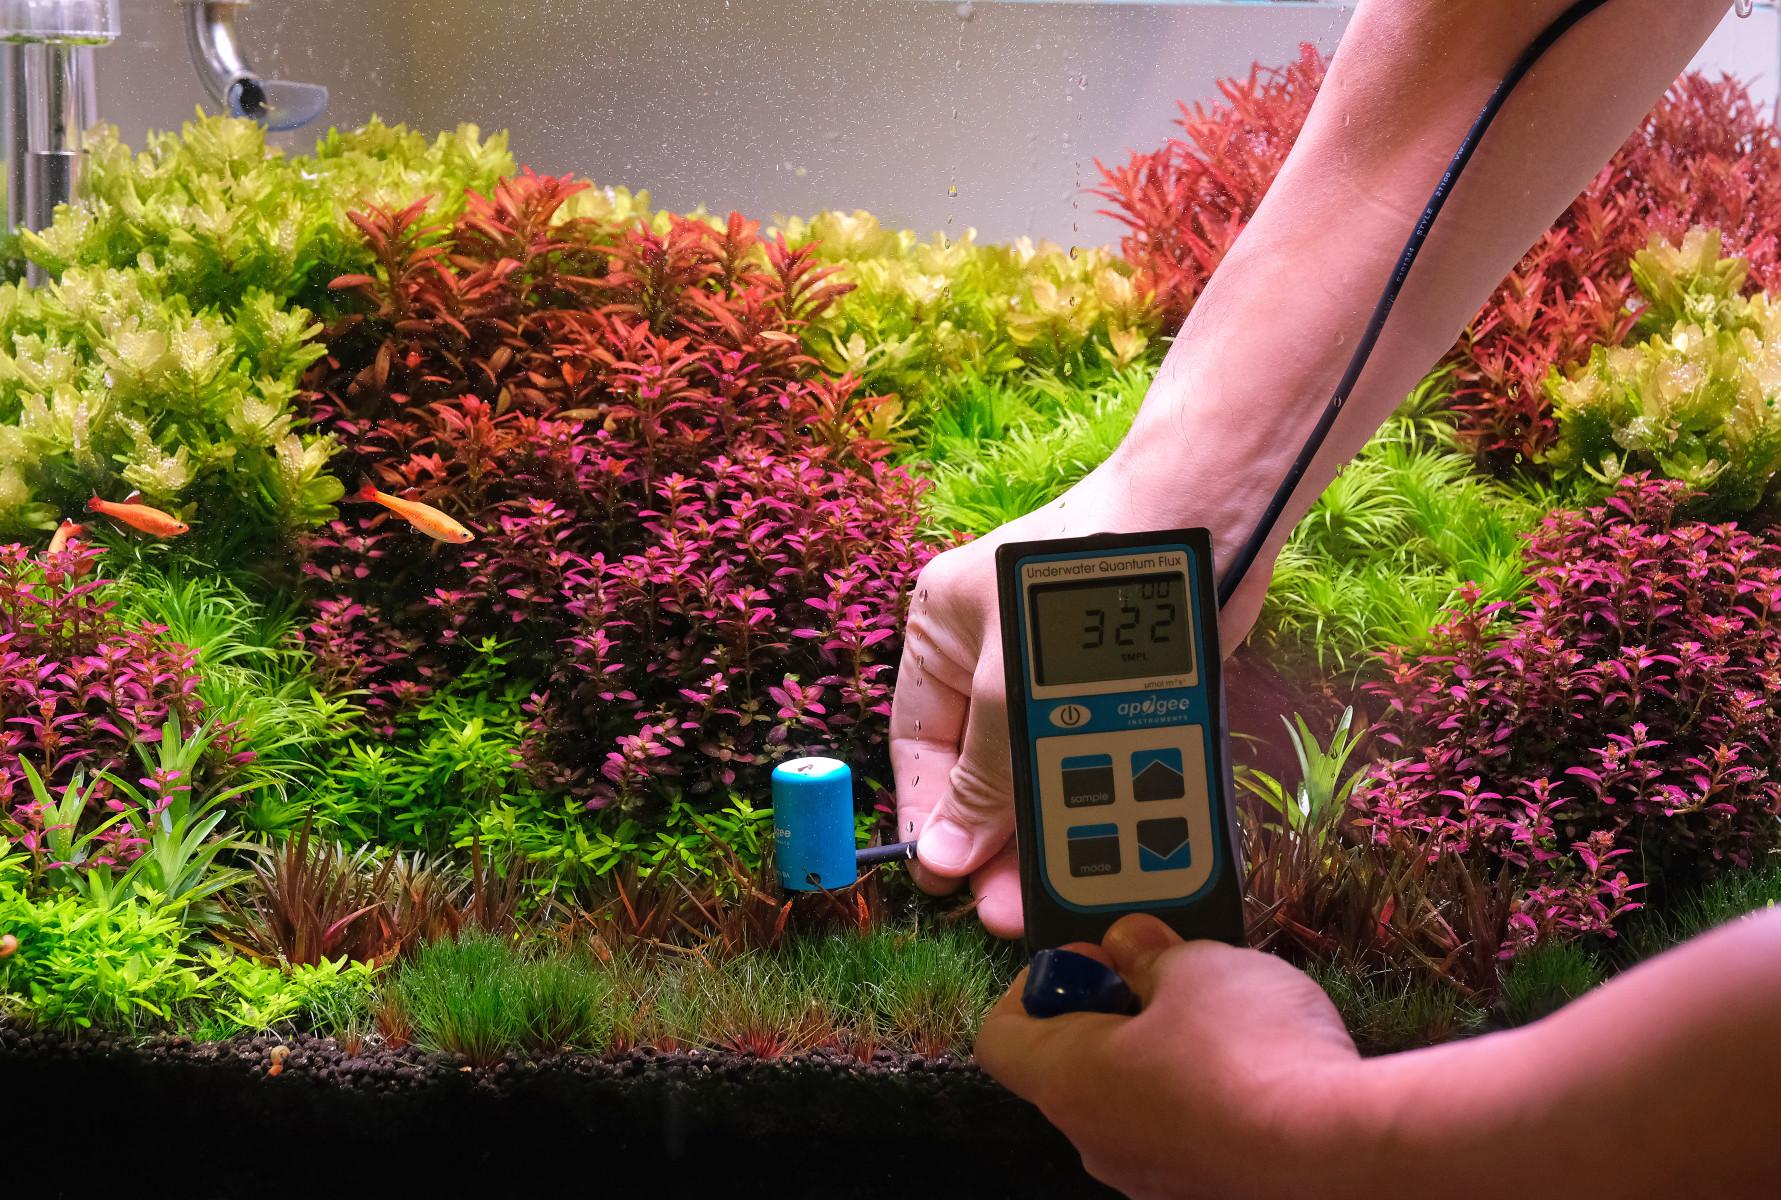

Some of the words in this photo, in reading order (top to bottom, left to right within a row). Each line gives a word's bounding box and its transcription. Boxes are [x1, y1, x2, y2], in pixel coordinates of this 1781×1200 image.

[1416, 207, 1434, 235] STYLE
[1435, 171, 1451, 197] 21100
[1026, 562, 1096, 579] Underwater
[1099, 558, 1156, 573] Quantum
[1158, 555, 1182, 568] Flux
[1082, 603, 1176, 649] 322
[1121, 652, 1149, 664] SMPL
[1117, 695, 1190, 718] apogee
[1128, 714, 1189, 726] INSTRUMENTS
[1070, 791, 1110, 805] sample
[1080, 862, 1112, 874] mode
